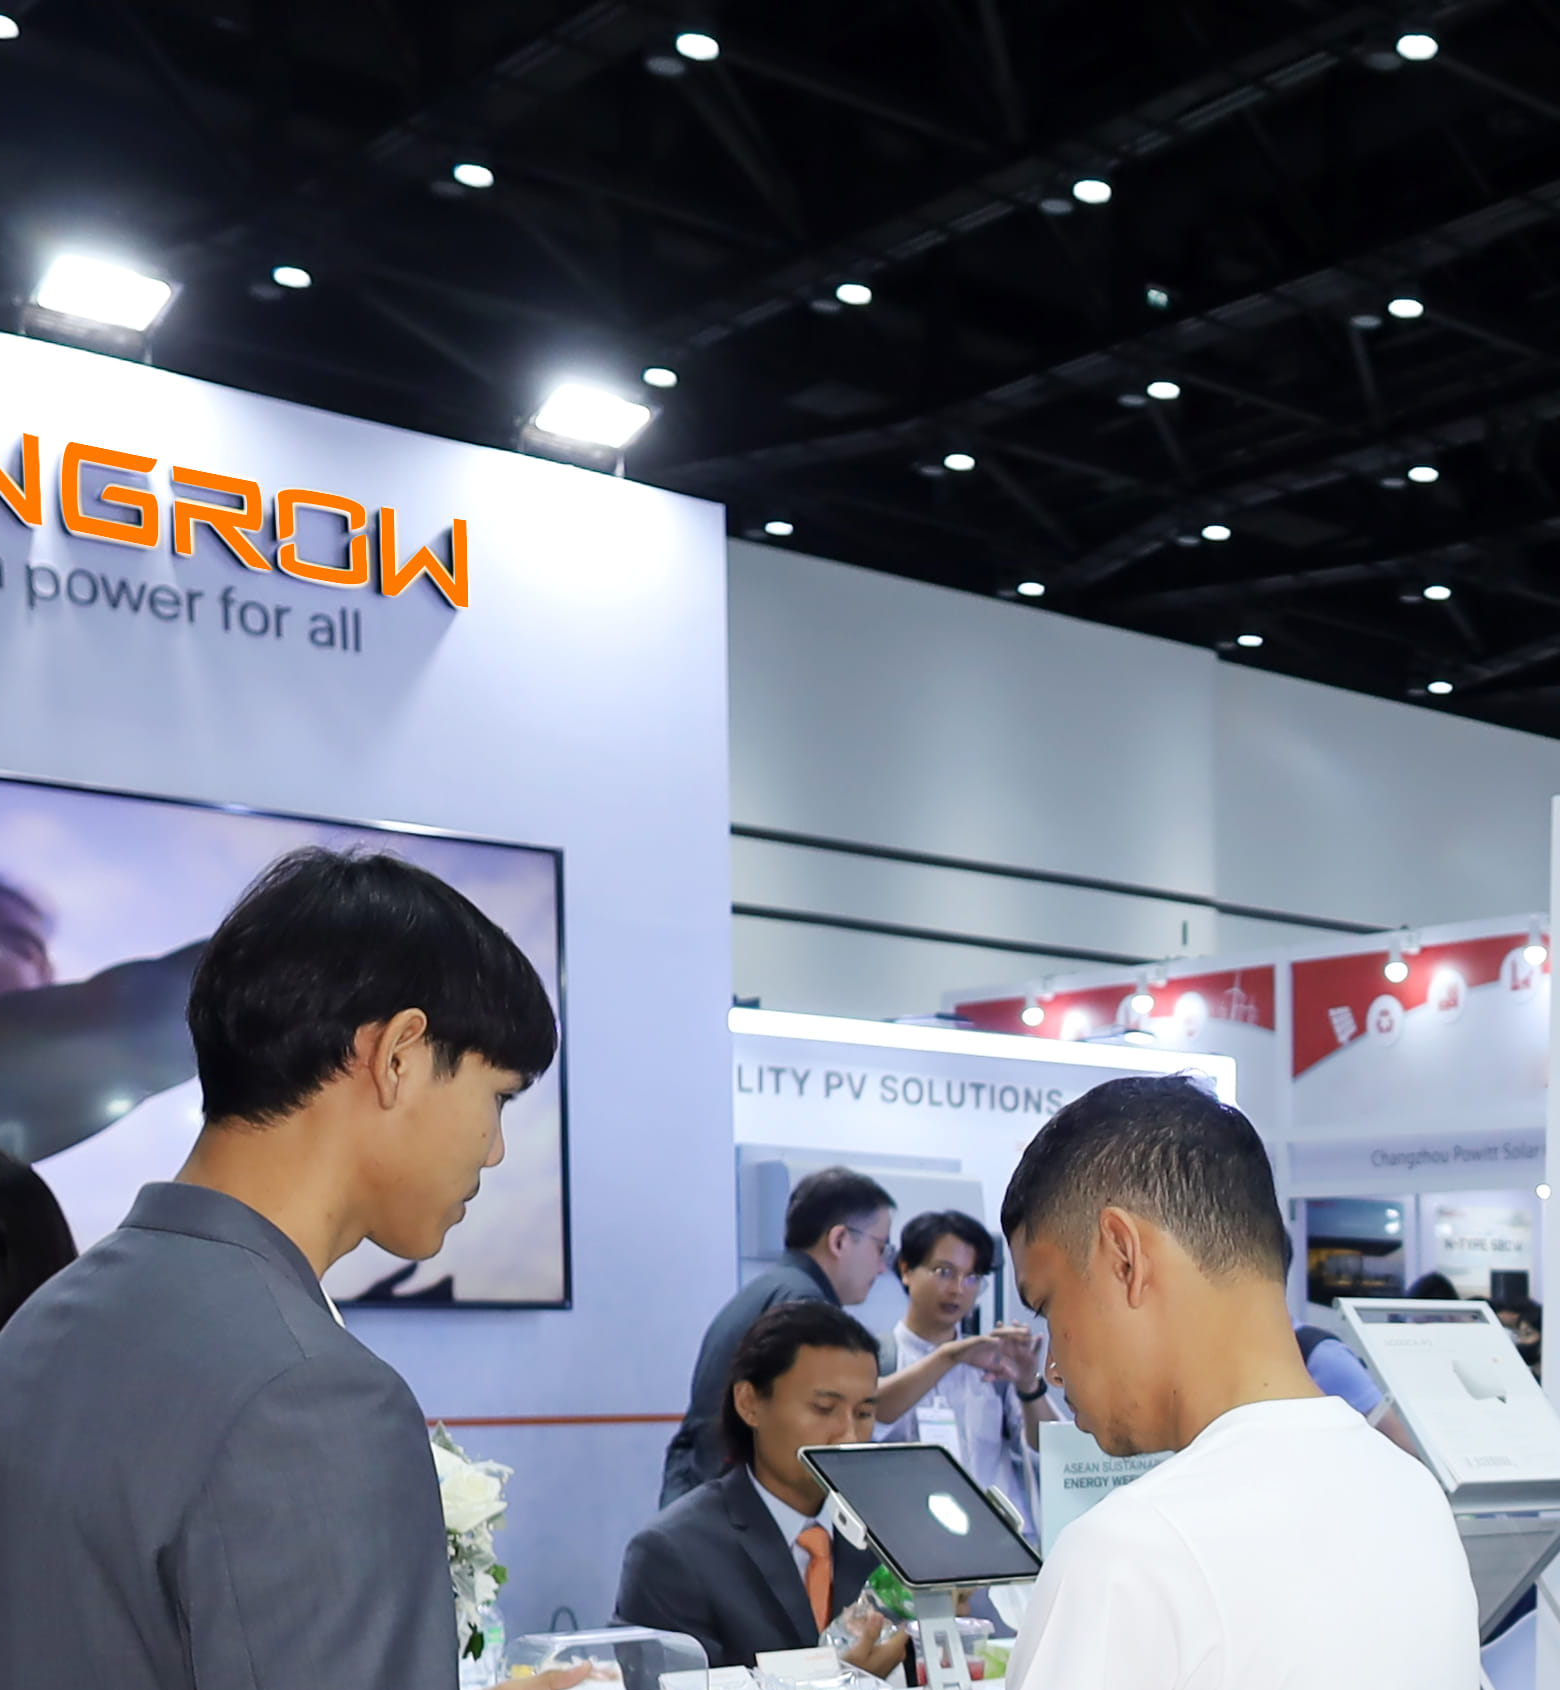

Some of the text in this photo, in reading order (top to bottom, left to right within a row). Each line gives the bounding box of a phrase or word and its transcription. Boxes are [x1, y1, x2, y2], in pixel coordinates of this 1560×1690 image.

[25, 552, 202, 627] power
[218, 586, 292, 641] for
[307, 604, 362, 653] all
[737, 1064, 1065, 1116] LITY PV SOLUTIONS
[1371, 1147, 1450, 1169] Changzhou
[1503, 1140, 1539, 1160] Solar
[1064, 1462, 1100, 1475] ASEAN
[1064, 1474, 1109, 1490] ENERGY
